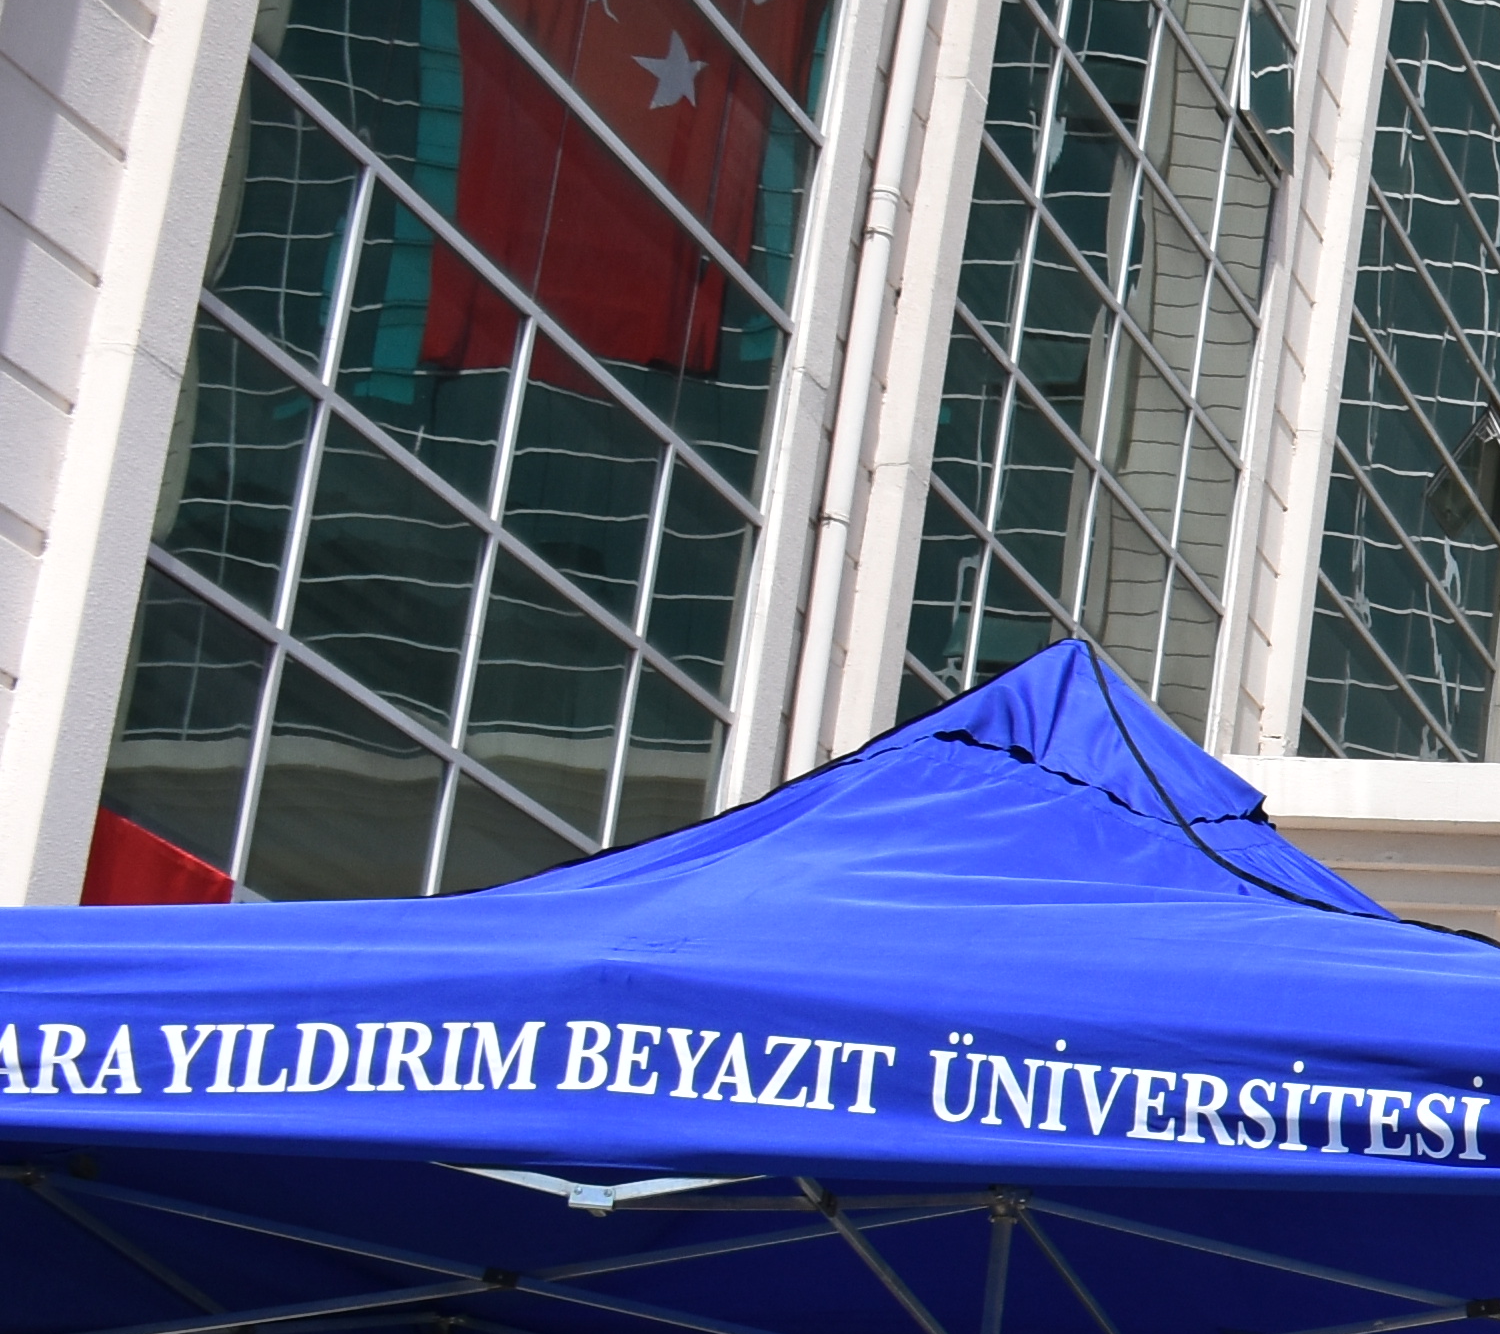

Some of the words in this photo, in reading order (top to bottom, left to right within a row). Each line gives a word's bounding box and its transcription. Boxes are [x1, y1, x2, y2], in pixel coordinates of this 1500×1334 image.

[160, 1021, 545, 1094] YILDIRIM
[557, 1021, 896, 1114] BEYAZIT
[930, 1031, 1490, 1161] ÜNİVERSİTESİ
